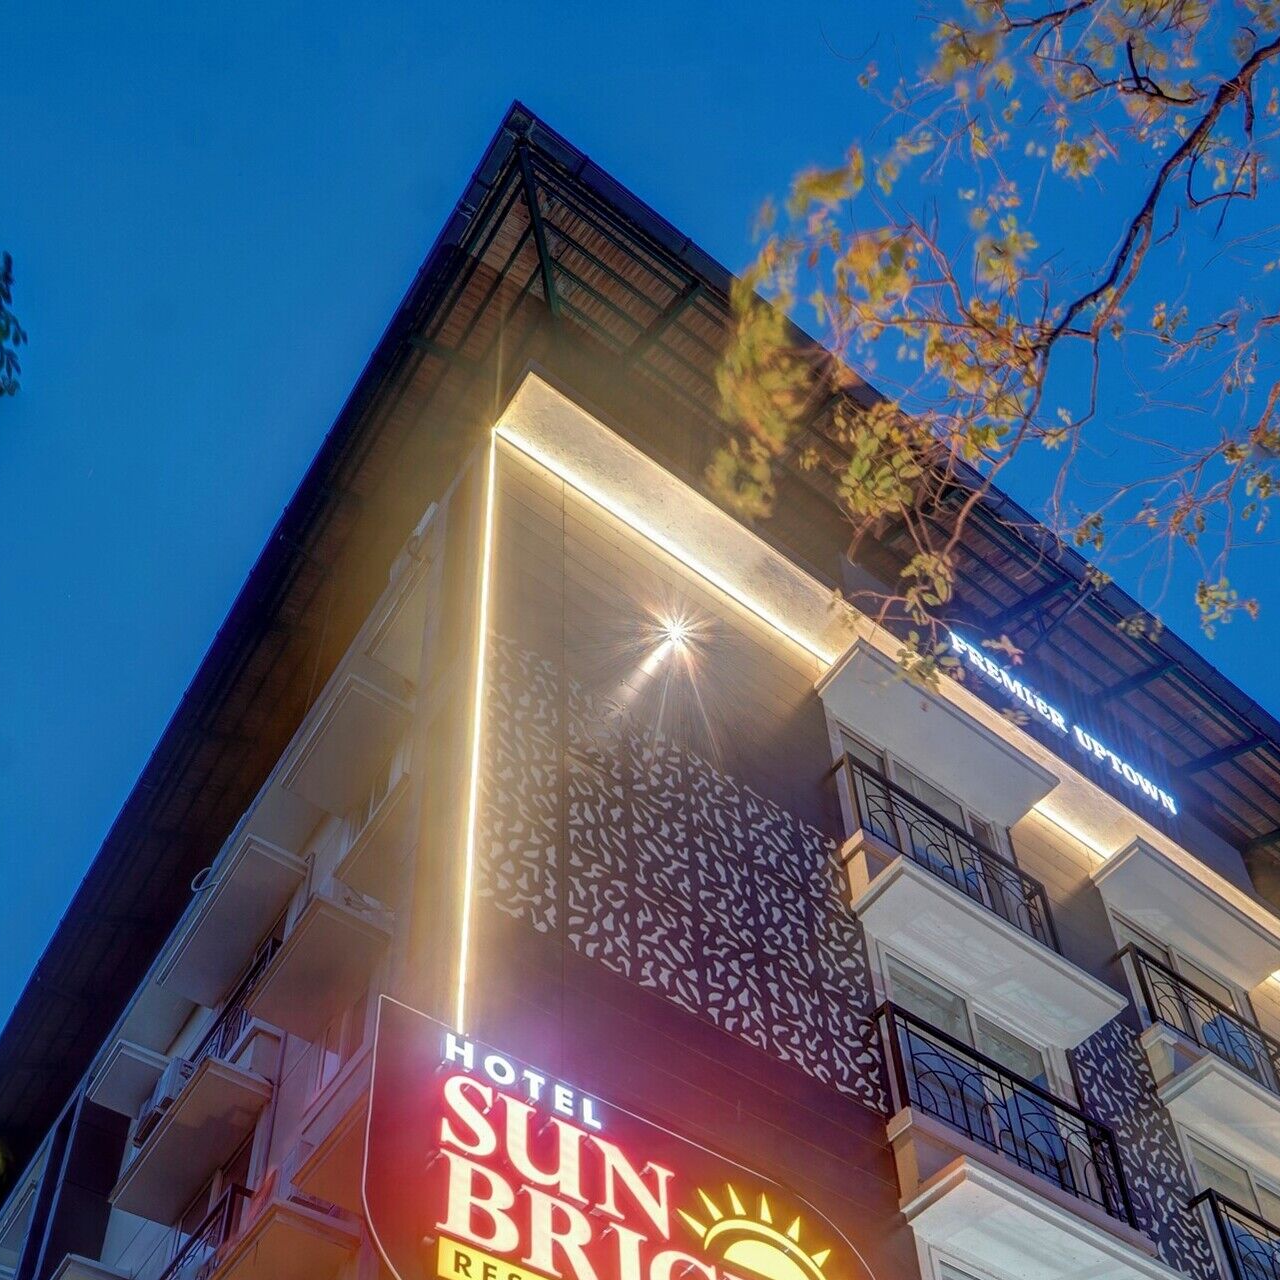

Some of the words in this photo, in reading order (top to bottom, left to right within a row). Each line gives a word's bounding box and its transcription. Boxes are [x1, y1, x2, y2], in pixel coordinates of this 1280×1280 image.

[949, 631, 1069, 734] PREMIER
[1073, 725, 1178, 815] UPTOWN
[440, 1074, 674, 1240] SUN
[444, 1032, 602, 1130] HOTEL
